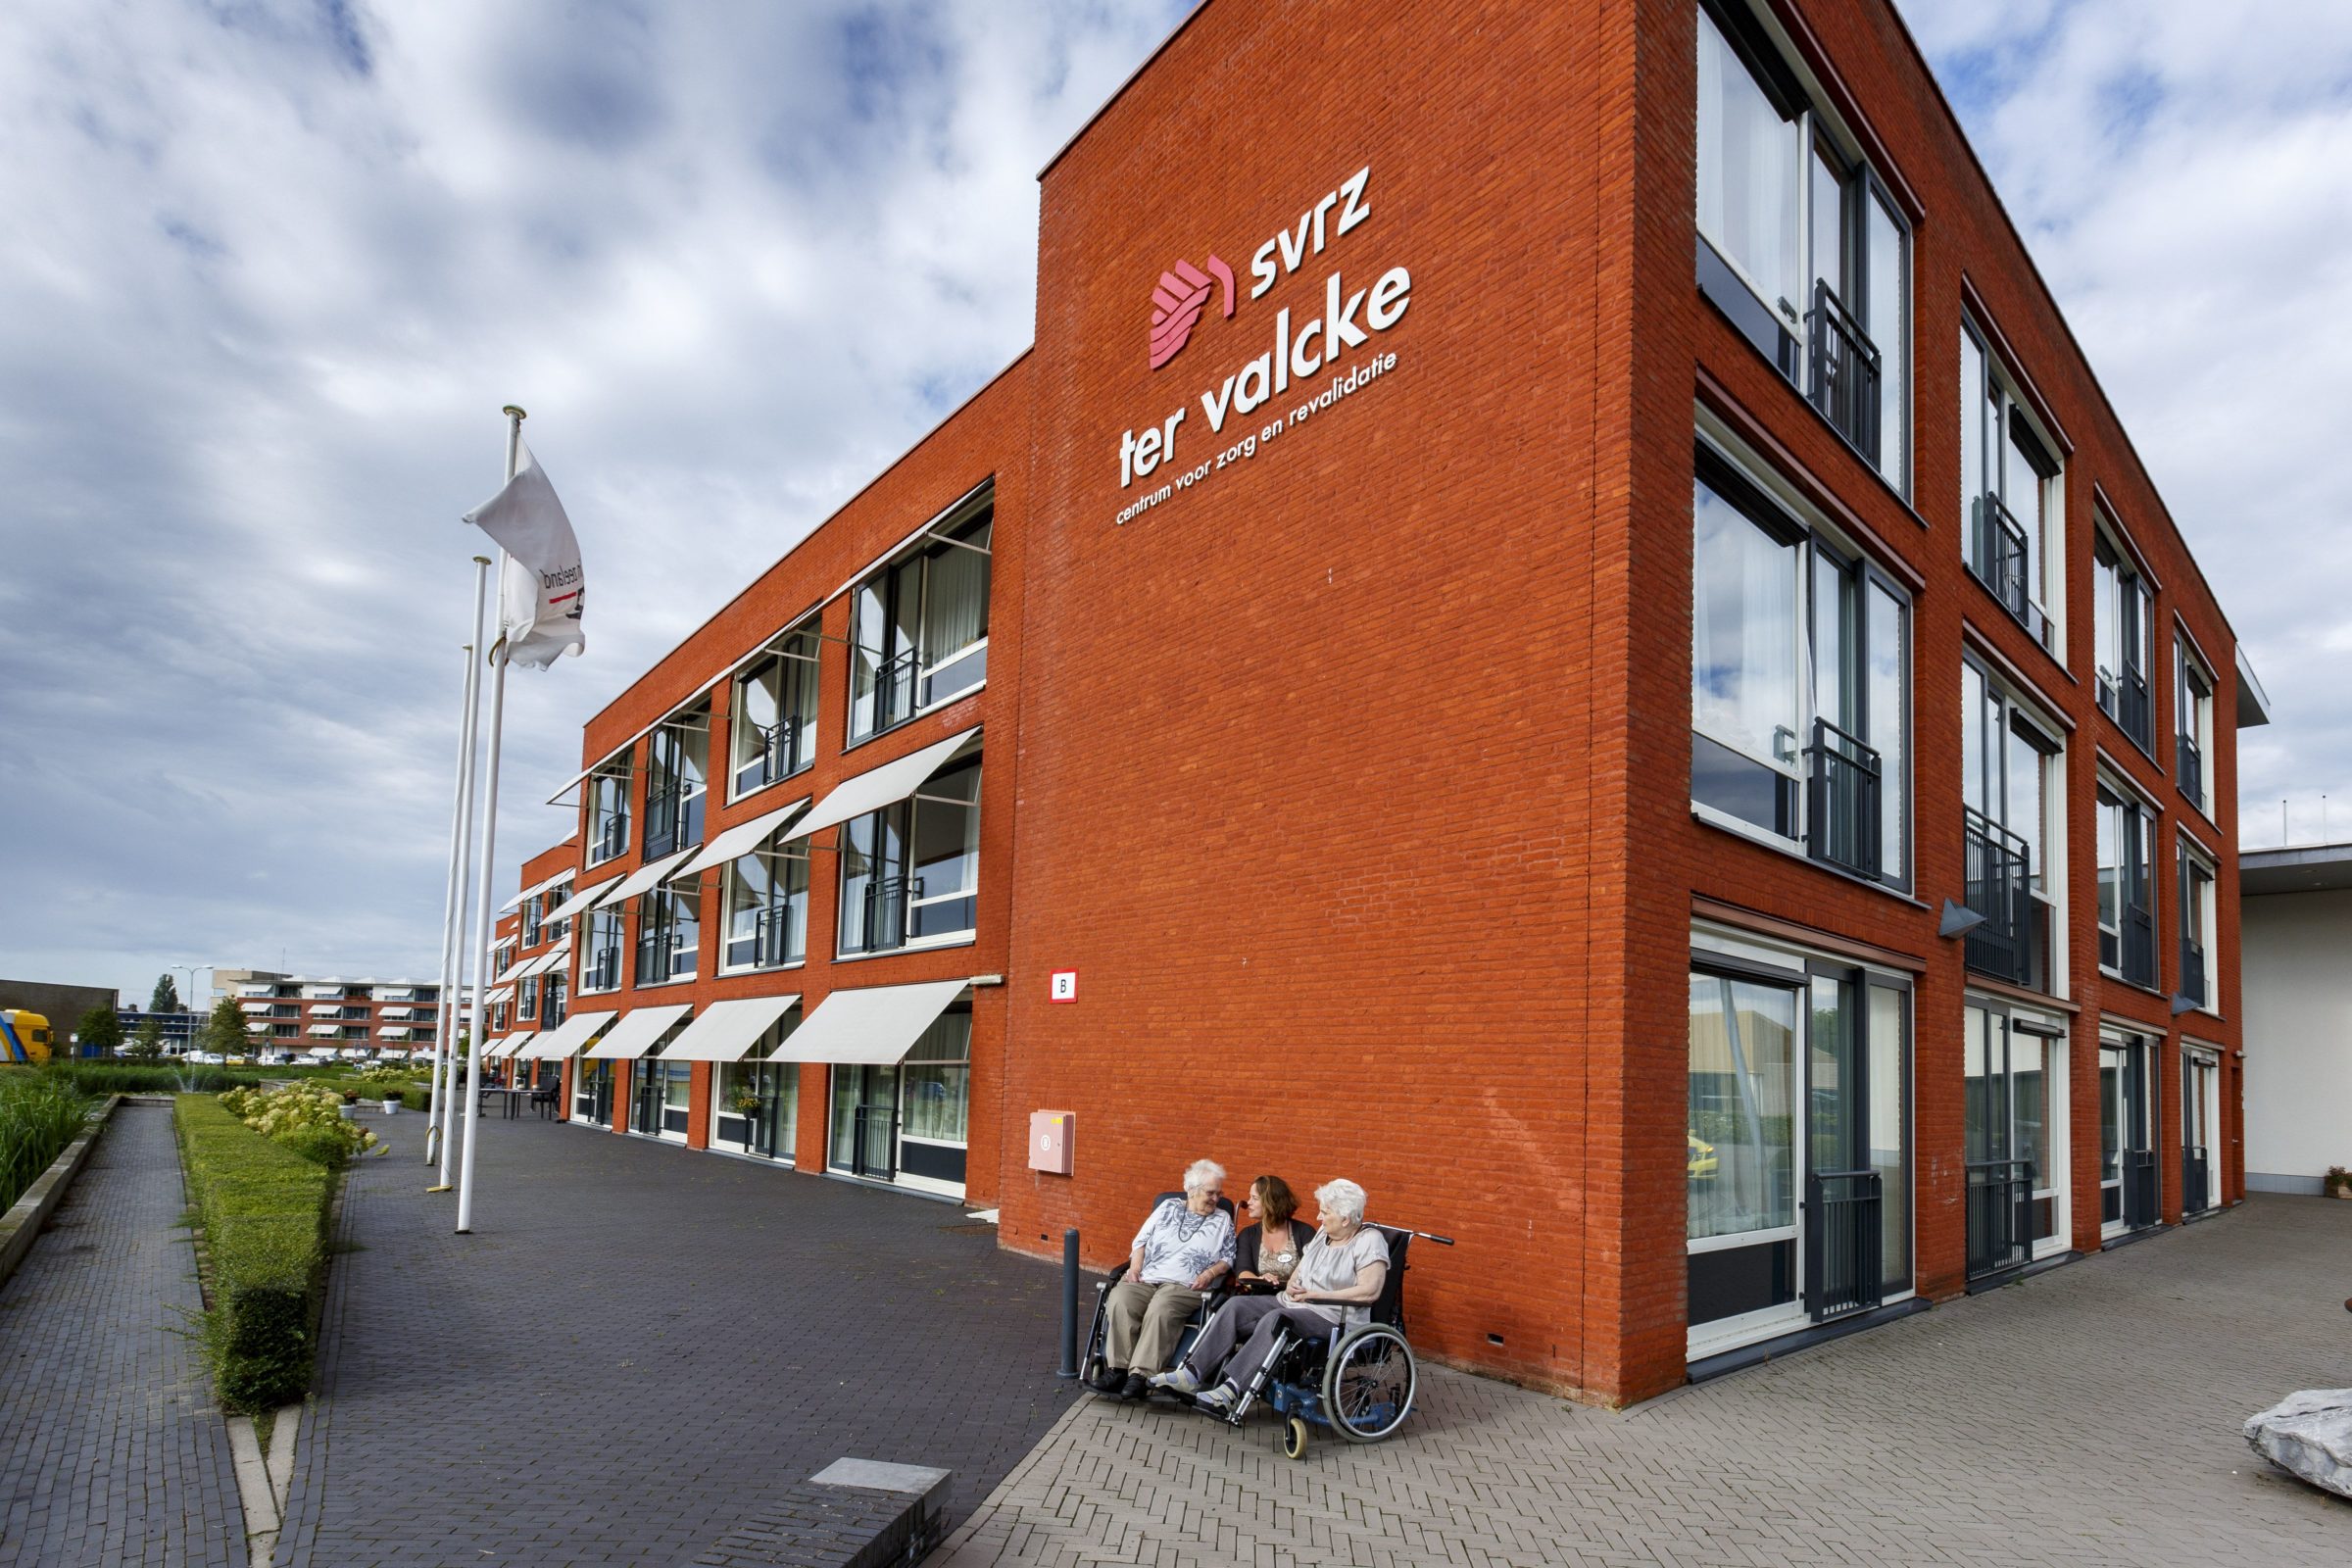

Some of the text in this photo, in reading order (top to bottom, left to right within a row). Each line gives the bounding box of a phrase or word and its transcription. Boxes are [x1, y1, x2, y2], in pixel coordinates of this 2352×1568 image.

[1250, 165, 1371, 300] svrz
[1116, 352, 1396, 525] centrum voor zorg en revalidatie
[1119, 266, 1411, 488] ter valcke
[1060, 979, 1067, 994] B
